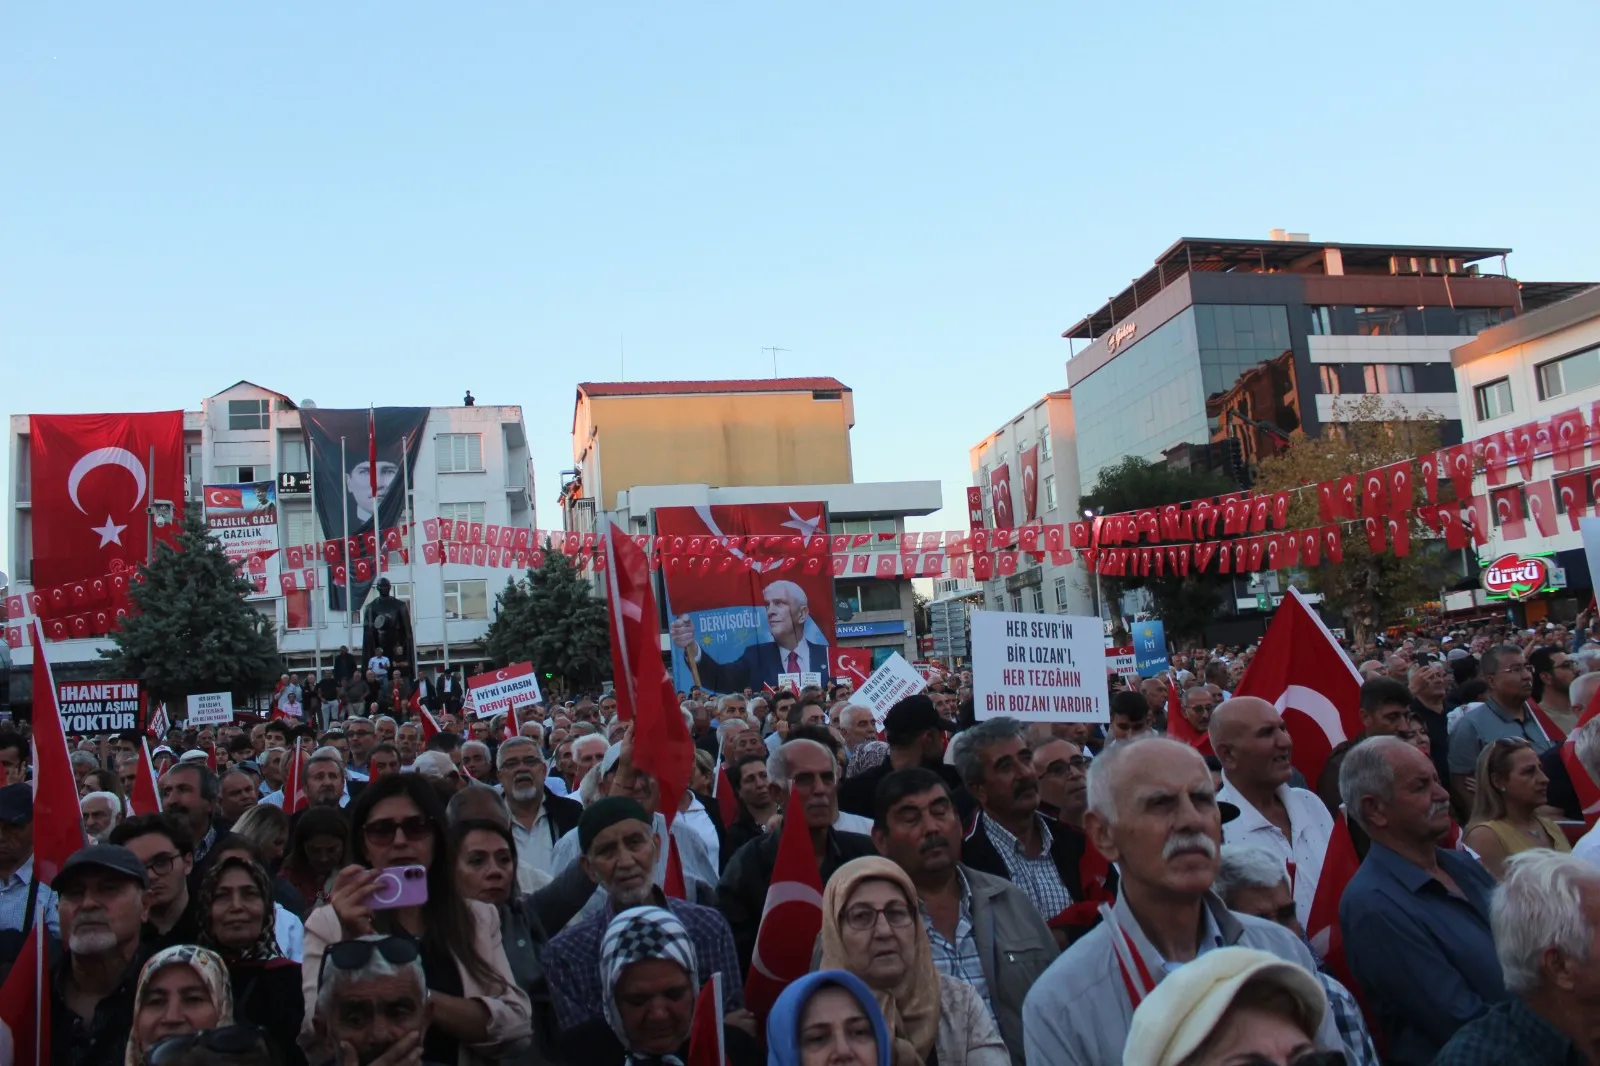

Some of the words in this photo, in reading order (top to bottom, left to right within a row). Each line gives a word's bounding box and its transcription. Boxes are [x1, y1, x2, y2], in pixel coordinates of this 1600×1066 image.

[252, 514, 274, 524] GAZİ
[224, 528, 262, 539] GAZİLİK
[1487, 562, 1539, 585] ÜLKÜ
[700, 610, 761, 632] DERVİŞOĞLU
[836, 625, 866, 634] ANKASI
[1006, 620, 1028, 638] HER
[1031, 620, 1072, 640] SEVR'İN
[1144, 639, 1154, 649] İYİ
[1007, 643, 1026, 663] BİR
[1030, 646, 1075, 667] LOZAN'I,
[1004, 669, 1024, 686] HER
[1028, 668, 1081, 687] TEZGÂHIN
[60, 684, 138, 701] İHANETİN
[500, 678, 532, 694] VARSIN
[862, 685, 874, 696] HER
[60, 702, 101, 714] ZAMAN
[105, 700, 138, 714] AŞIMI
[875, 699, 886, 711] HER
[986, 692, 1006, 711] BİR
[1010, 694, 1050, 712] BOZANI
[1053, 696, 1092, 712] VARDIR
[61, 713, 136, 732] YOKTUR
